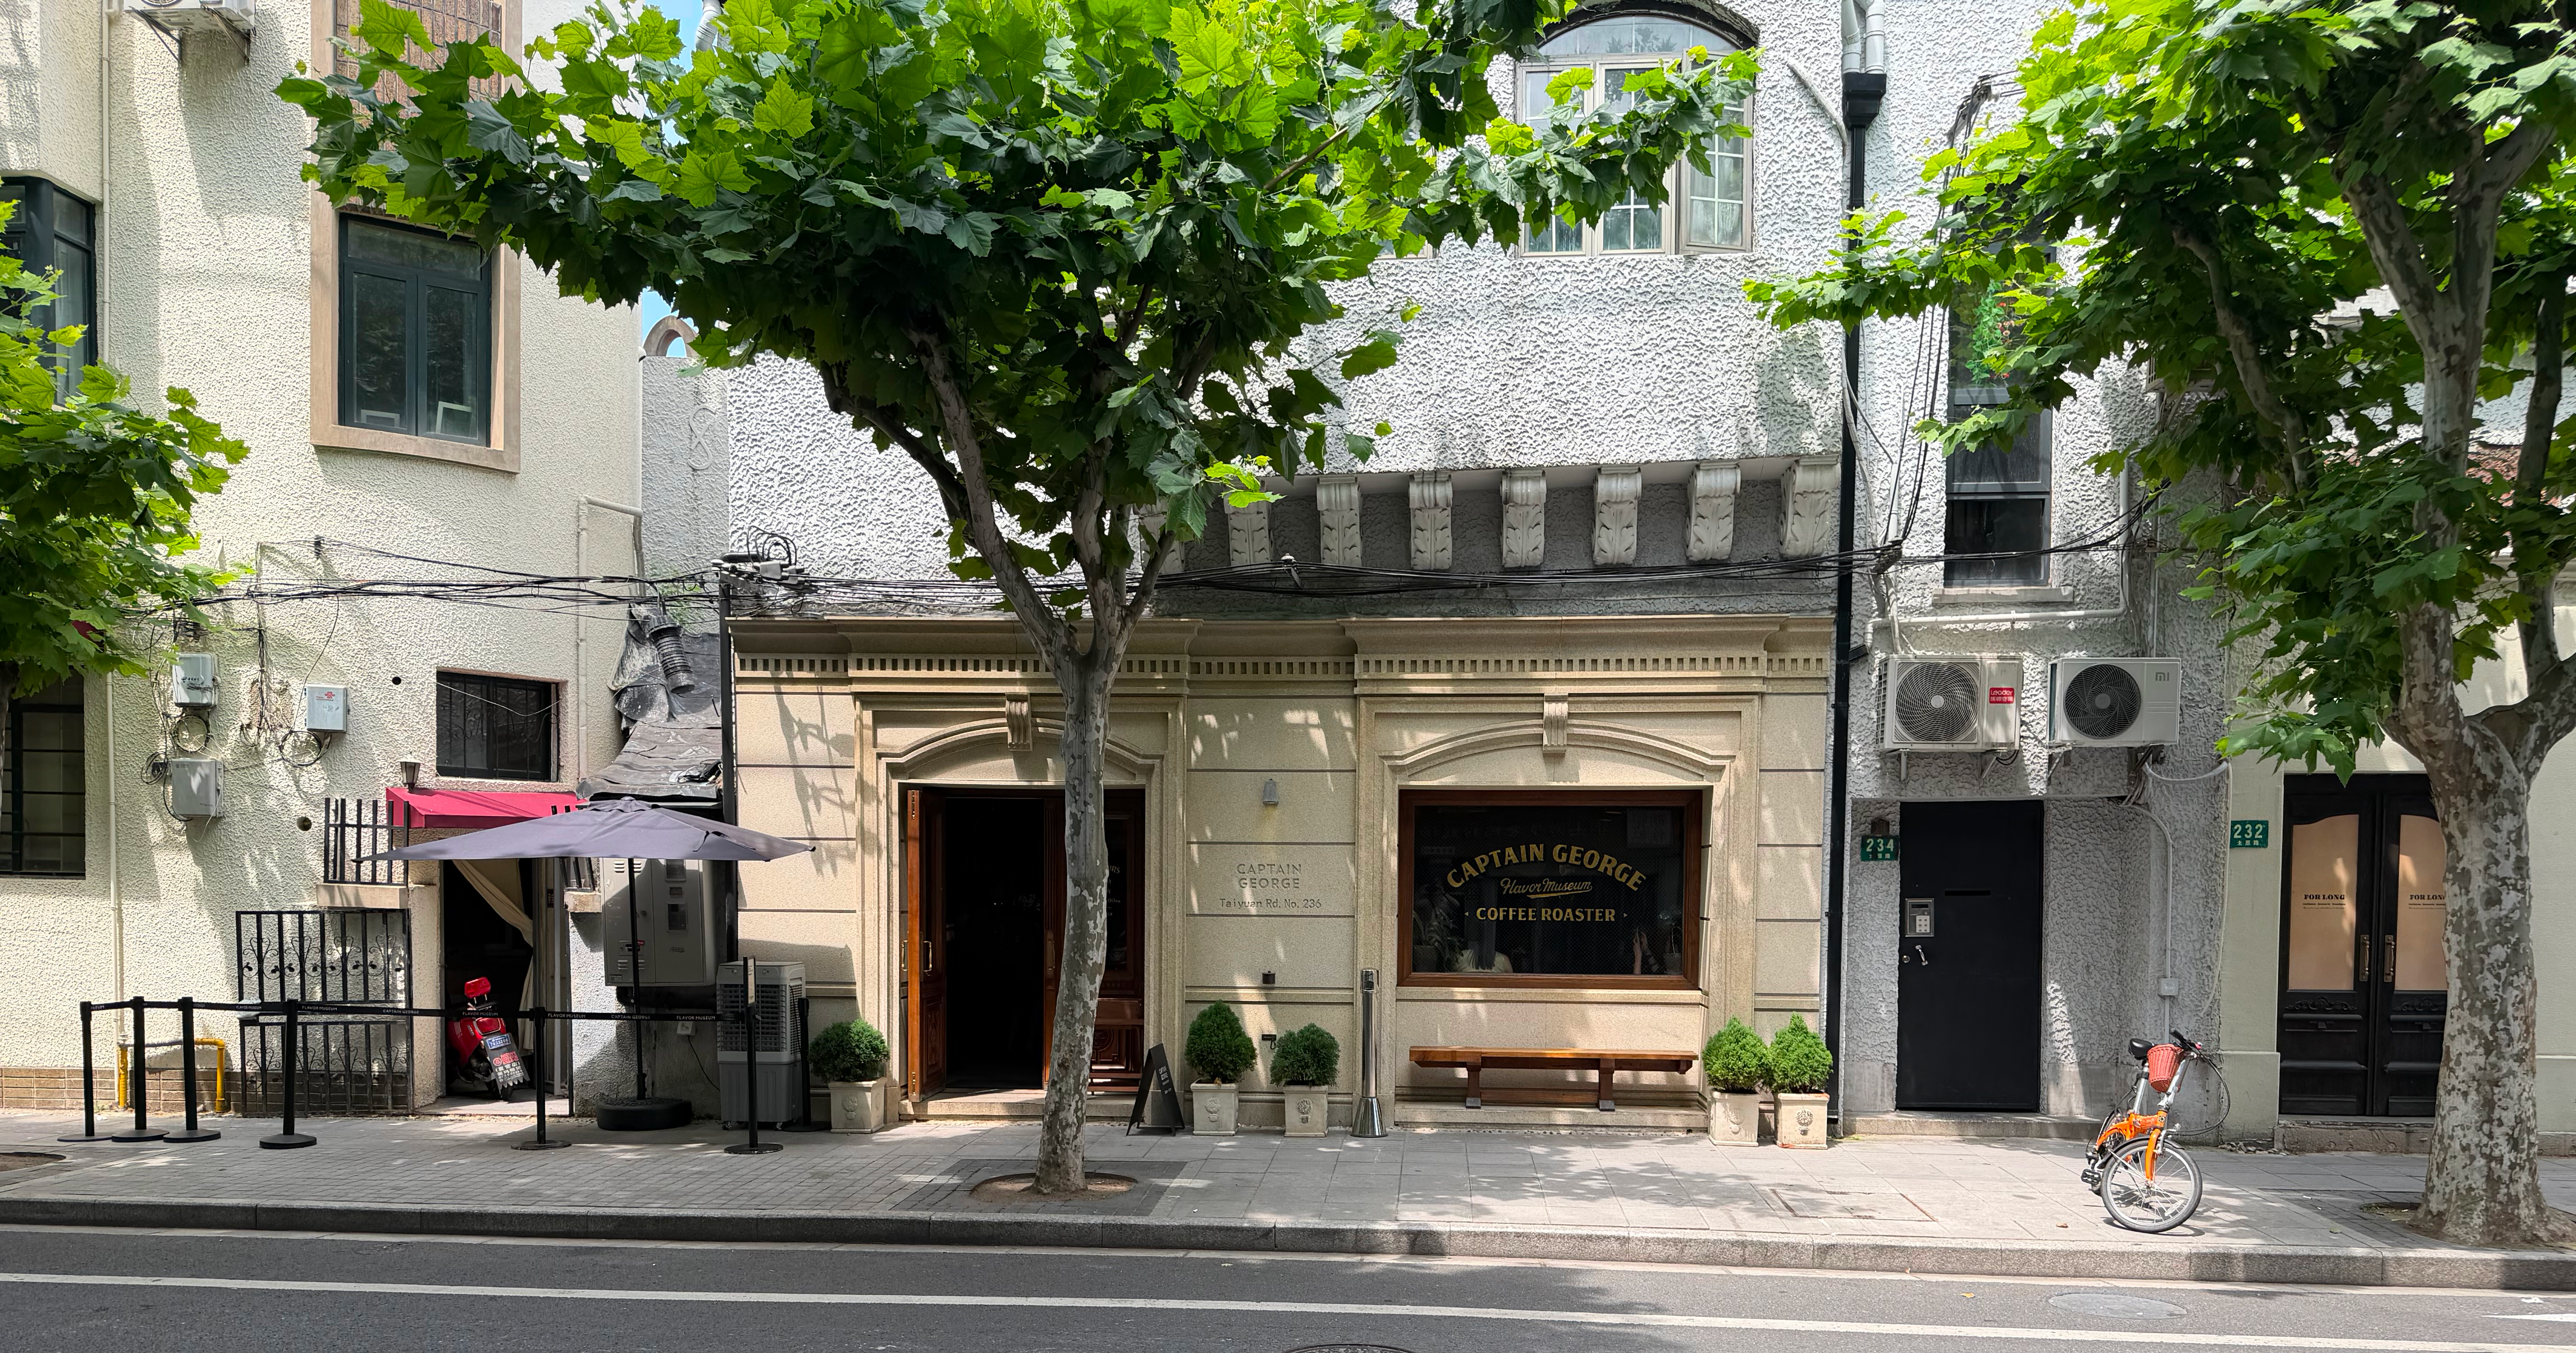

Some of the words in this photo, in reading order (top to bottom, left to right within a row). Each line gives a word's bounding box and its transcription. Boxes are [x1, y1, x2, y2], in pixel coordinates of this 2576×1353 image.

[2234, 824, 2263, 838] 232
[1866, 838, 1894, 851] 234
[1237, 864, 1302, 874] CAPTAIN
[1447, 844, 1544, 887] CAPTAIN
[1552, 844, 1646, 892] GEORGE
[1238, 878, 1300, 888] GEORGE
[1219, 898, 1262, 909] Taiyuan
[1266, 898, 1281, 908] Rd.
[1284, 899, 1299, 908] No.
[1303, 898, 1321, 908] 236
[1477, 907, 1536, 921] COFFEE
[1541, 908, 1615, 921] ROASTER
